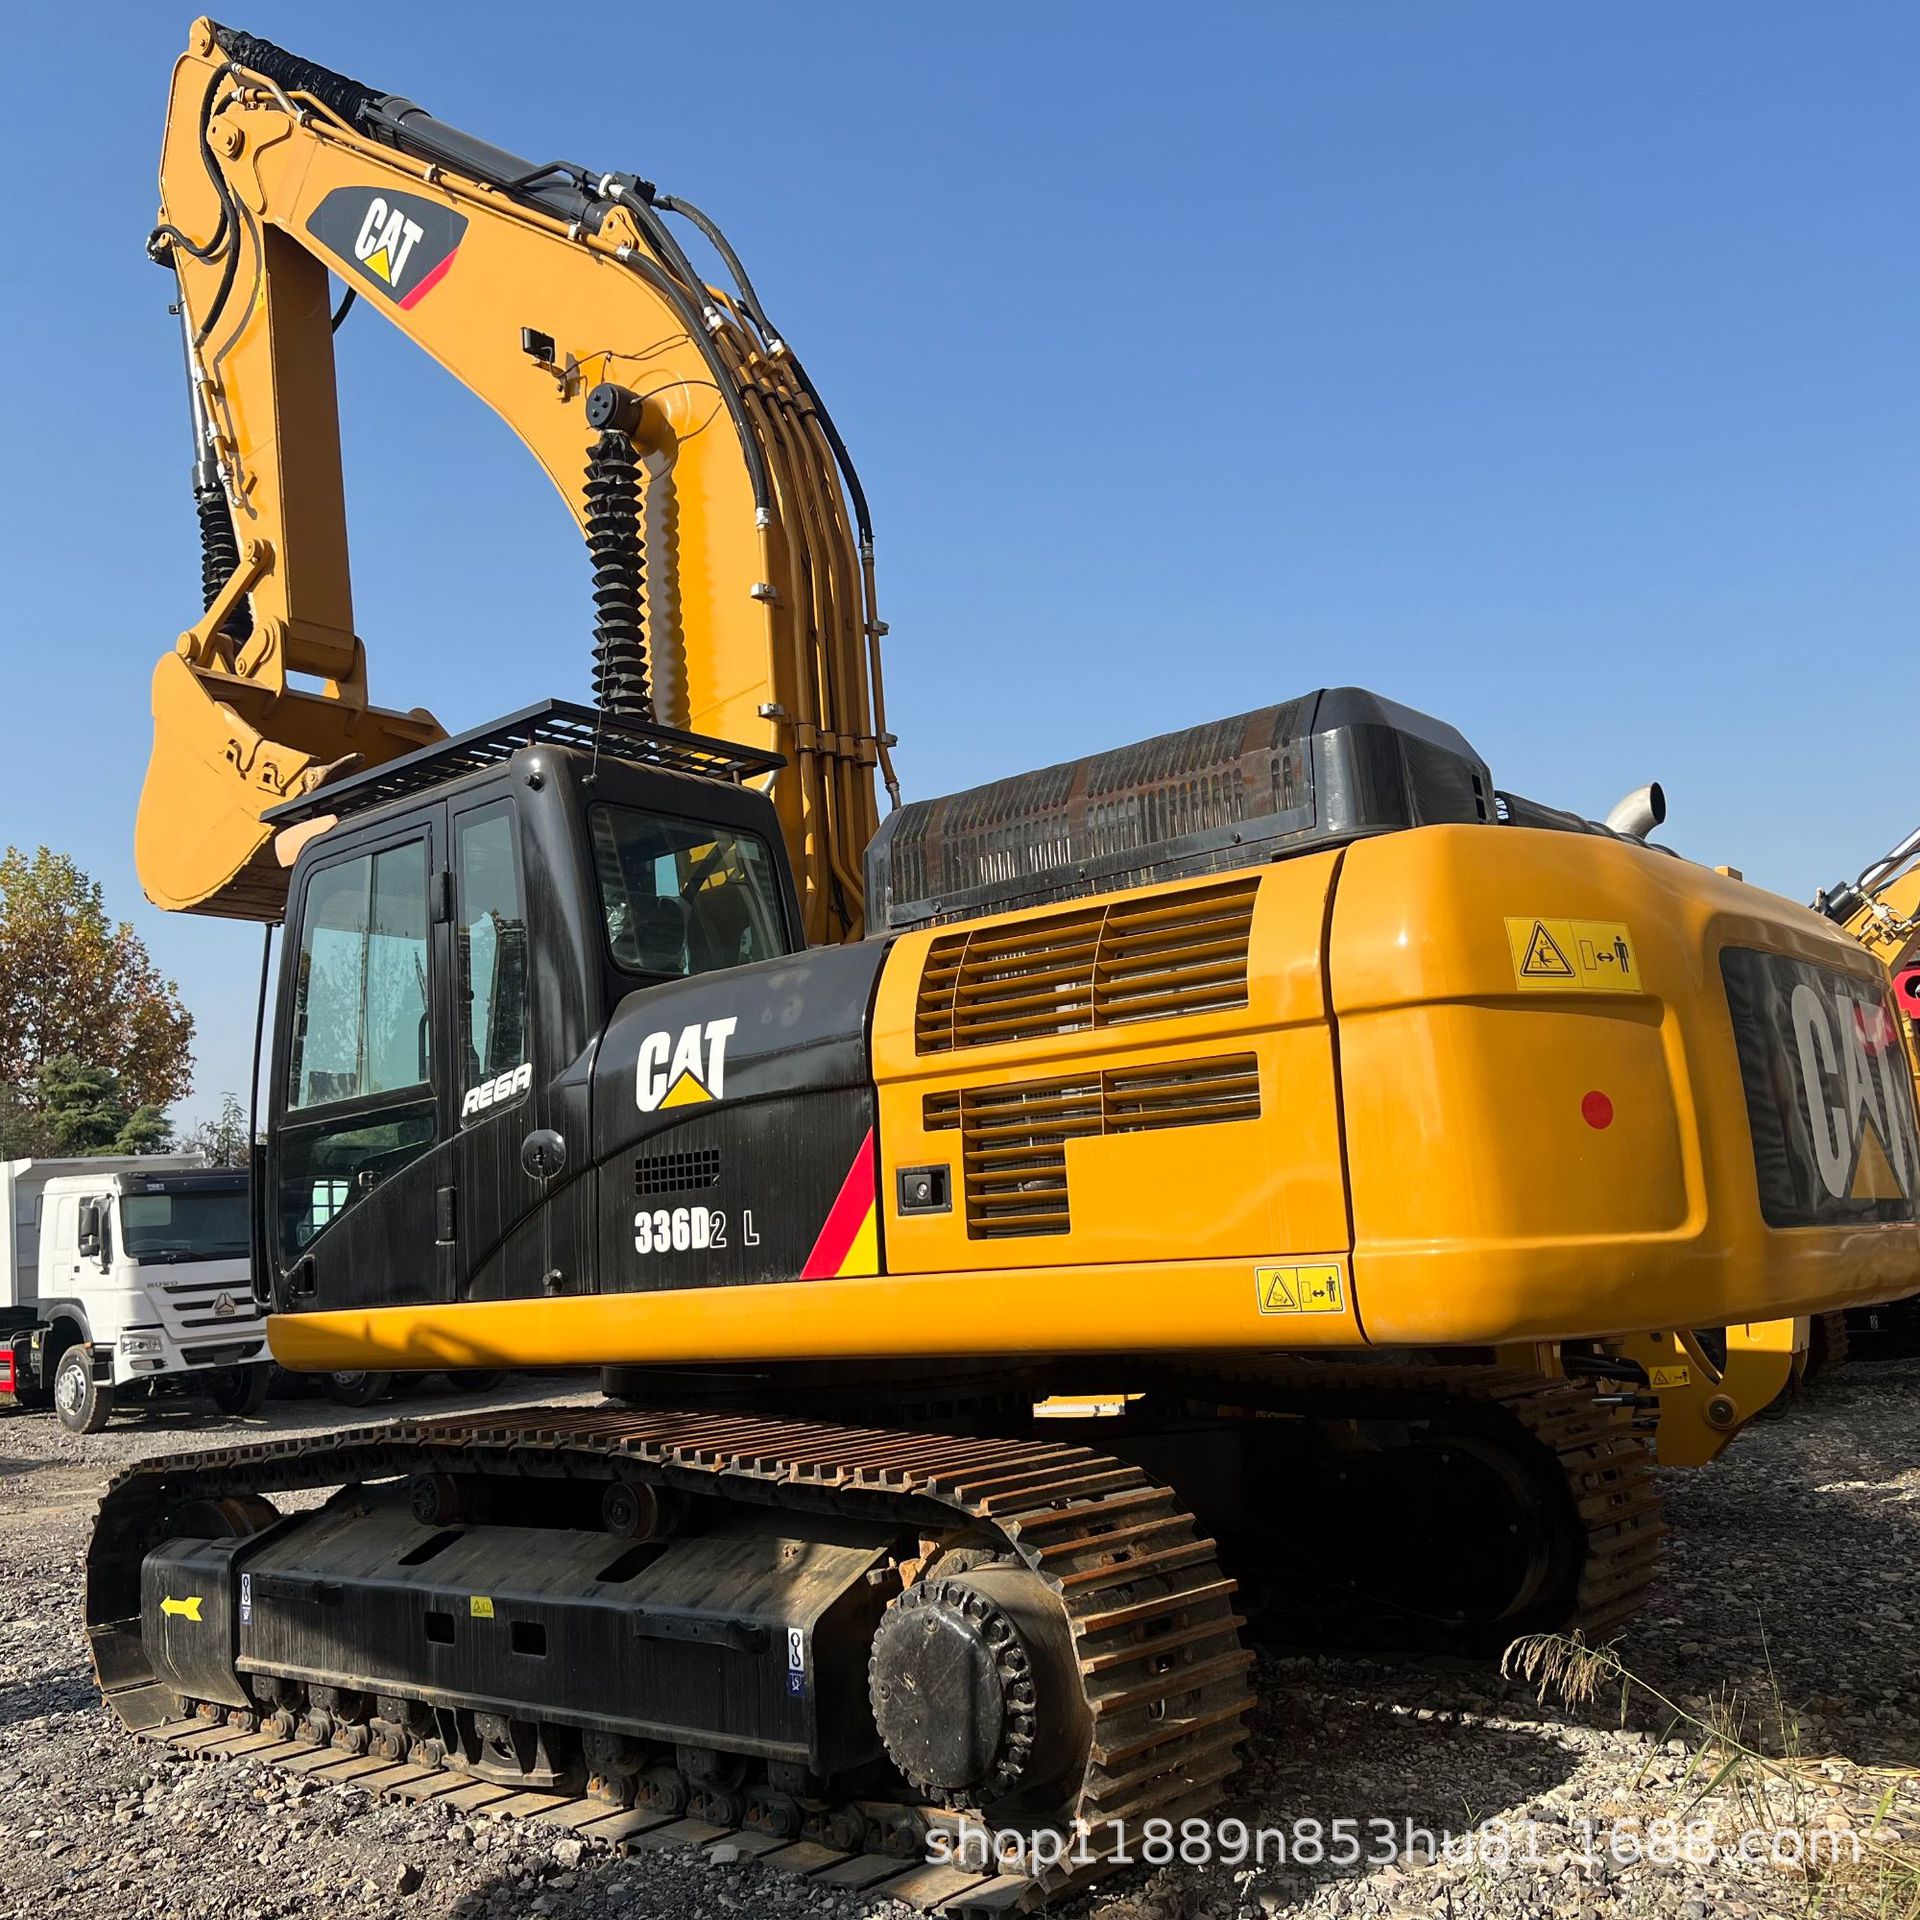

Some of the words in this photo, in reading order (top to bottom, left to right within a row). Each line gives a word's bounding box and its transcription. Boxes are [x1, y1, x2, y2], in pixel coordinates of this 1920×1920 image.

[354, 197, 425, 288] CAT
[636, 1016, 738, 1113] CAT
[1791, 983, 1909, 1199] CAT
[634, 1206, 727, 1254] 336D2
[743, 1209, 760, 1246] L
